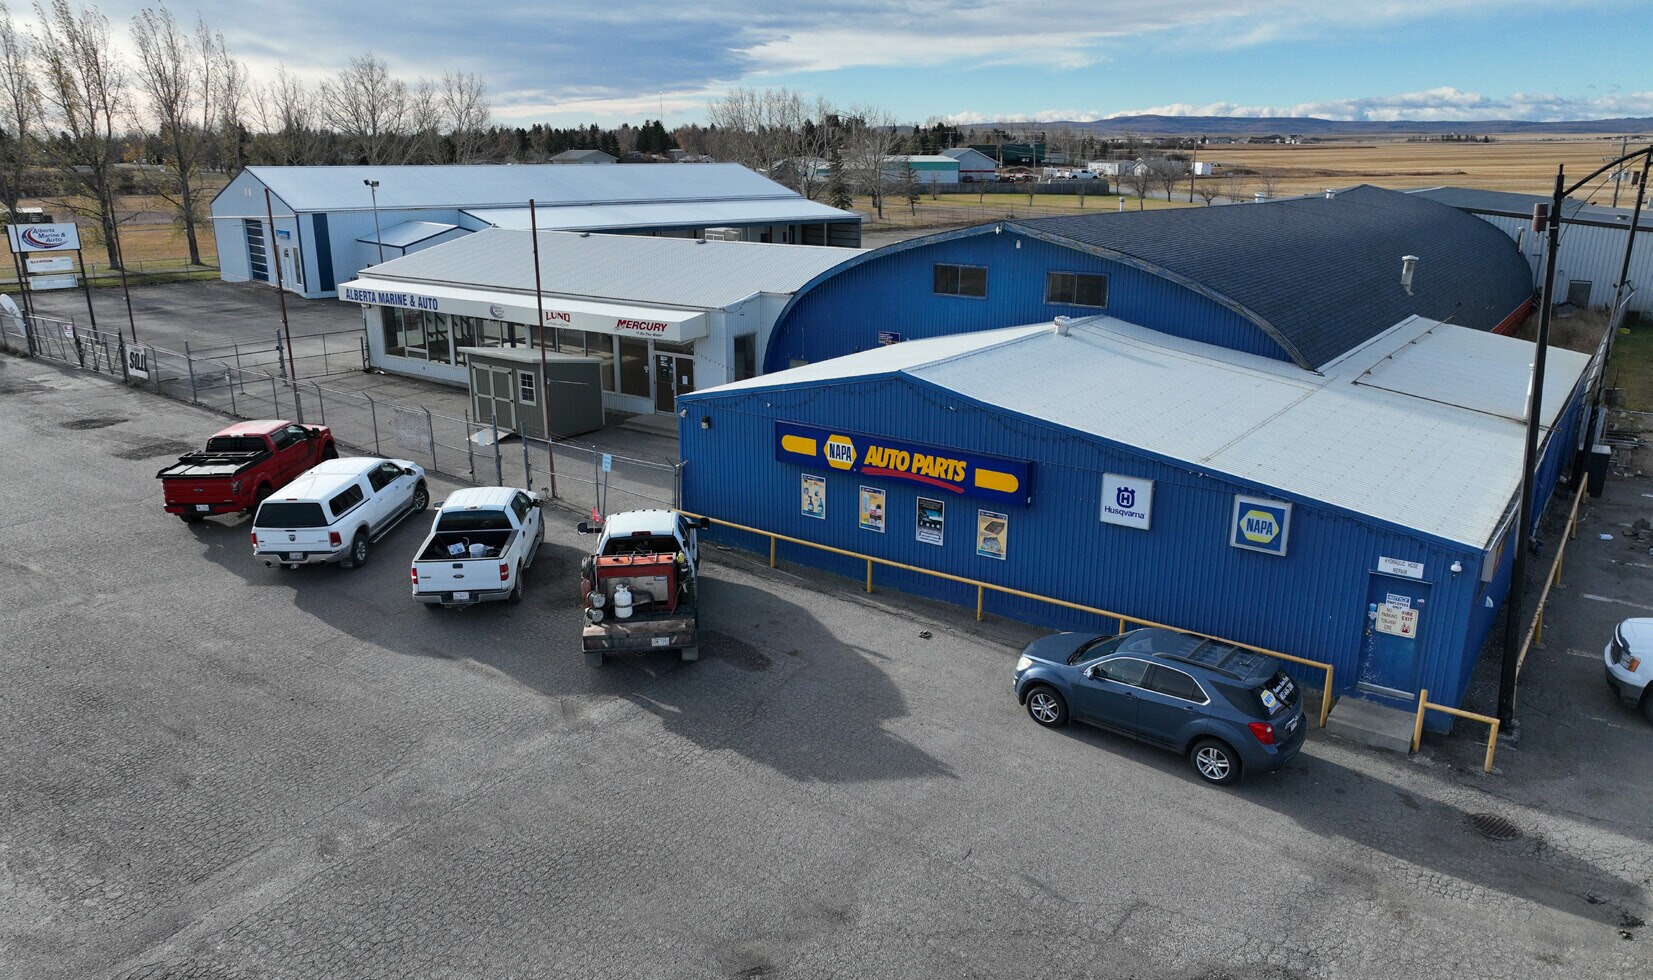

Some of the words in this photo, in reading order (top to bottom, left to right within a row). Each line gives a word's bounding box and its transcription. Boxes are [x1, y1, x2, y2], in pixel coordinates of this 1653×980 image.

[345, 288, 377, 303] ALBERTA
[378, 292, 408, 306] MARINE
[409, 295, 415, 307] &
[418, 296, 438, 311] AUTO
[545, 311, 571, 323] LUND
[616, 319, 667, 332] MERCURY
[829, 443, 852, 462] NAPA
[864, 445, 910, 472] AUTO
[911, 453, 967, 482] PARTS
[1104, 505, 1145, 519] Husqvarna
[1246, 517, 1273, 536] NAPA
[1392, 567, 1408, 575] REPAIR
